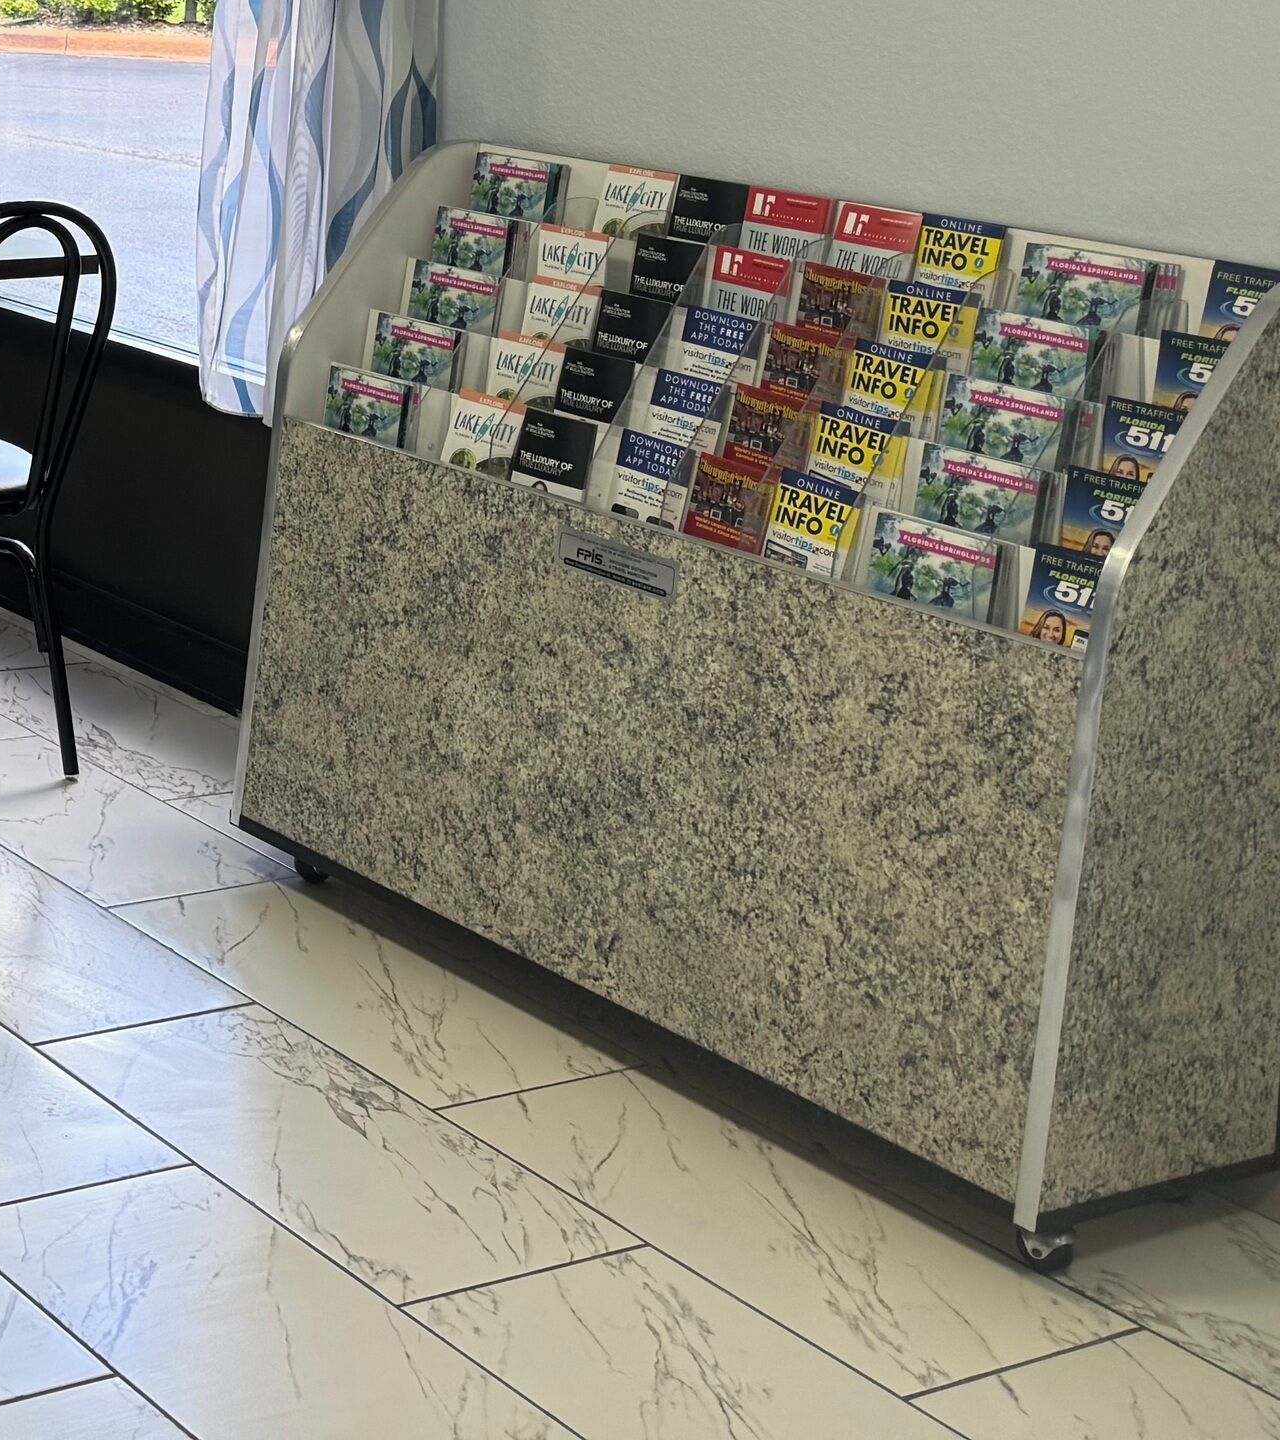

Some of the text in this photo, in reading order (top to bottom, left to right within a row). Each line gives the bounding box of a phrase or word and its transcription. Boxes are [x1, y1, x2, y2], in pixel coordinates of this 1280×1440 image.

[604, 182, 632, 204] LAKE
[674, 215, 713, 230] THE LUXURY
[940, 218, 983, 234] ONLINE
[542, 242, 568, 262] LAKE
[748, 229, 809, 259] THE WORLD
[924, 228, 990, 256] TRAVEL
[835, 248, 903, 279] THE WORLD
[921, 247, 968, 271] INFO
[1050, 259, 1139, 281] FLORIDA'S SPRINGLANDS
[1217, 271, 1241, 283] FREE
[634, 275, 646, 285] THE
[646, 276, 673, 290] LUXURY
[906, 285, 952, 301] ONLINE
[529, 295, 557, 315] LAKE
[716, 289, 778, 321] THE WORLD
[890, 294, 964, 325] TRAVEL
[694, 310, 753, 331] DOWNLOAD
[888, 314, 940, 339] INFO
[598, 331, 648, 350] THE LUXURY OF
[690, 331, 745, 351] APP TODAY
[699, 322, 745, 341] THE FREE
[1003, 326, 1084, 349] FLORIDA'S SPRINGLANDS
[1171, 337, 1194, 349] FREE
[495, 351, 524, 374] LAKE
[870, 344, 913, 364] ONLINE
[855, 352, 920, 386] TRAVEL
[665, 373, 721, 395] DOWNLOAD
[669, 385, 713, 404] THE FREE
[850, 371, 897, 400] INFO
[561, 388, 614, 409] THE LUXURY OF
[659, 395, 679, 405] APP
[974, 393, 1059, 418] FLORIDA'S SPRINGLANDS
[837, 408, 881, 430] ONLINE
[1111, 400, 1174, 421] FREE TRAFFIC
[453, 411, 482, 434] LAKE
[1119, 415, 1166, 432] FLORIDA
[820, 416, 889, 454] TRAVEL
[1125, 425, 1176, 453] 511
[629, 434, 685, 459] DOWNLOAD
[634, 446, 677, 467] THE FREE
[816, 435, 865, 465] INFO
[520, 449, 573, 472] THE LUXURY OF
[625, 455, 643, 467] APP
[947, 463, 984, 478] FLORIDA'S
[797, 478, 841, 500] ONLINE
[1084, 473, 1106, 487] FREE
[780, 485, 846, 524] TRAVEL
[775, 505, 823, 536] INFO
[902, 534, 940, 550] FLORIDA'S
[1041, 554, 1064, 567] FREE
[1048, 569, 1096, 589] FLORIDA
